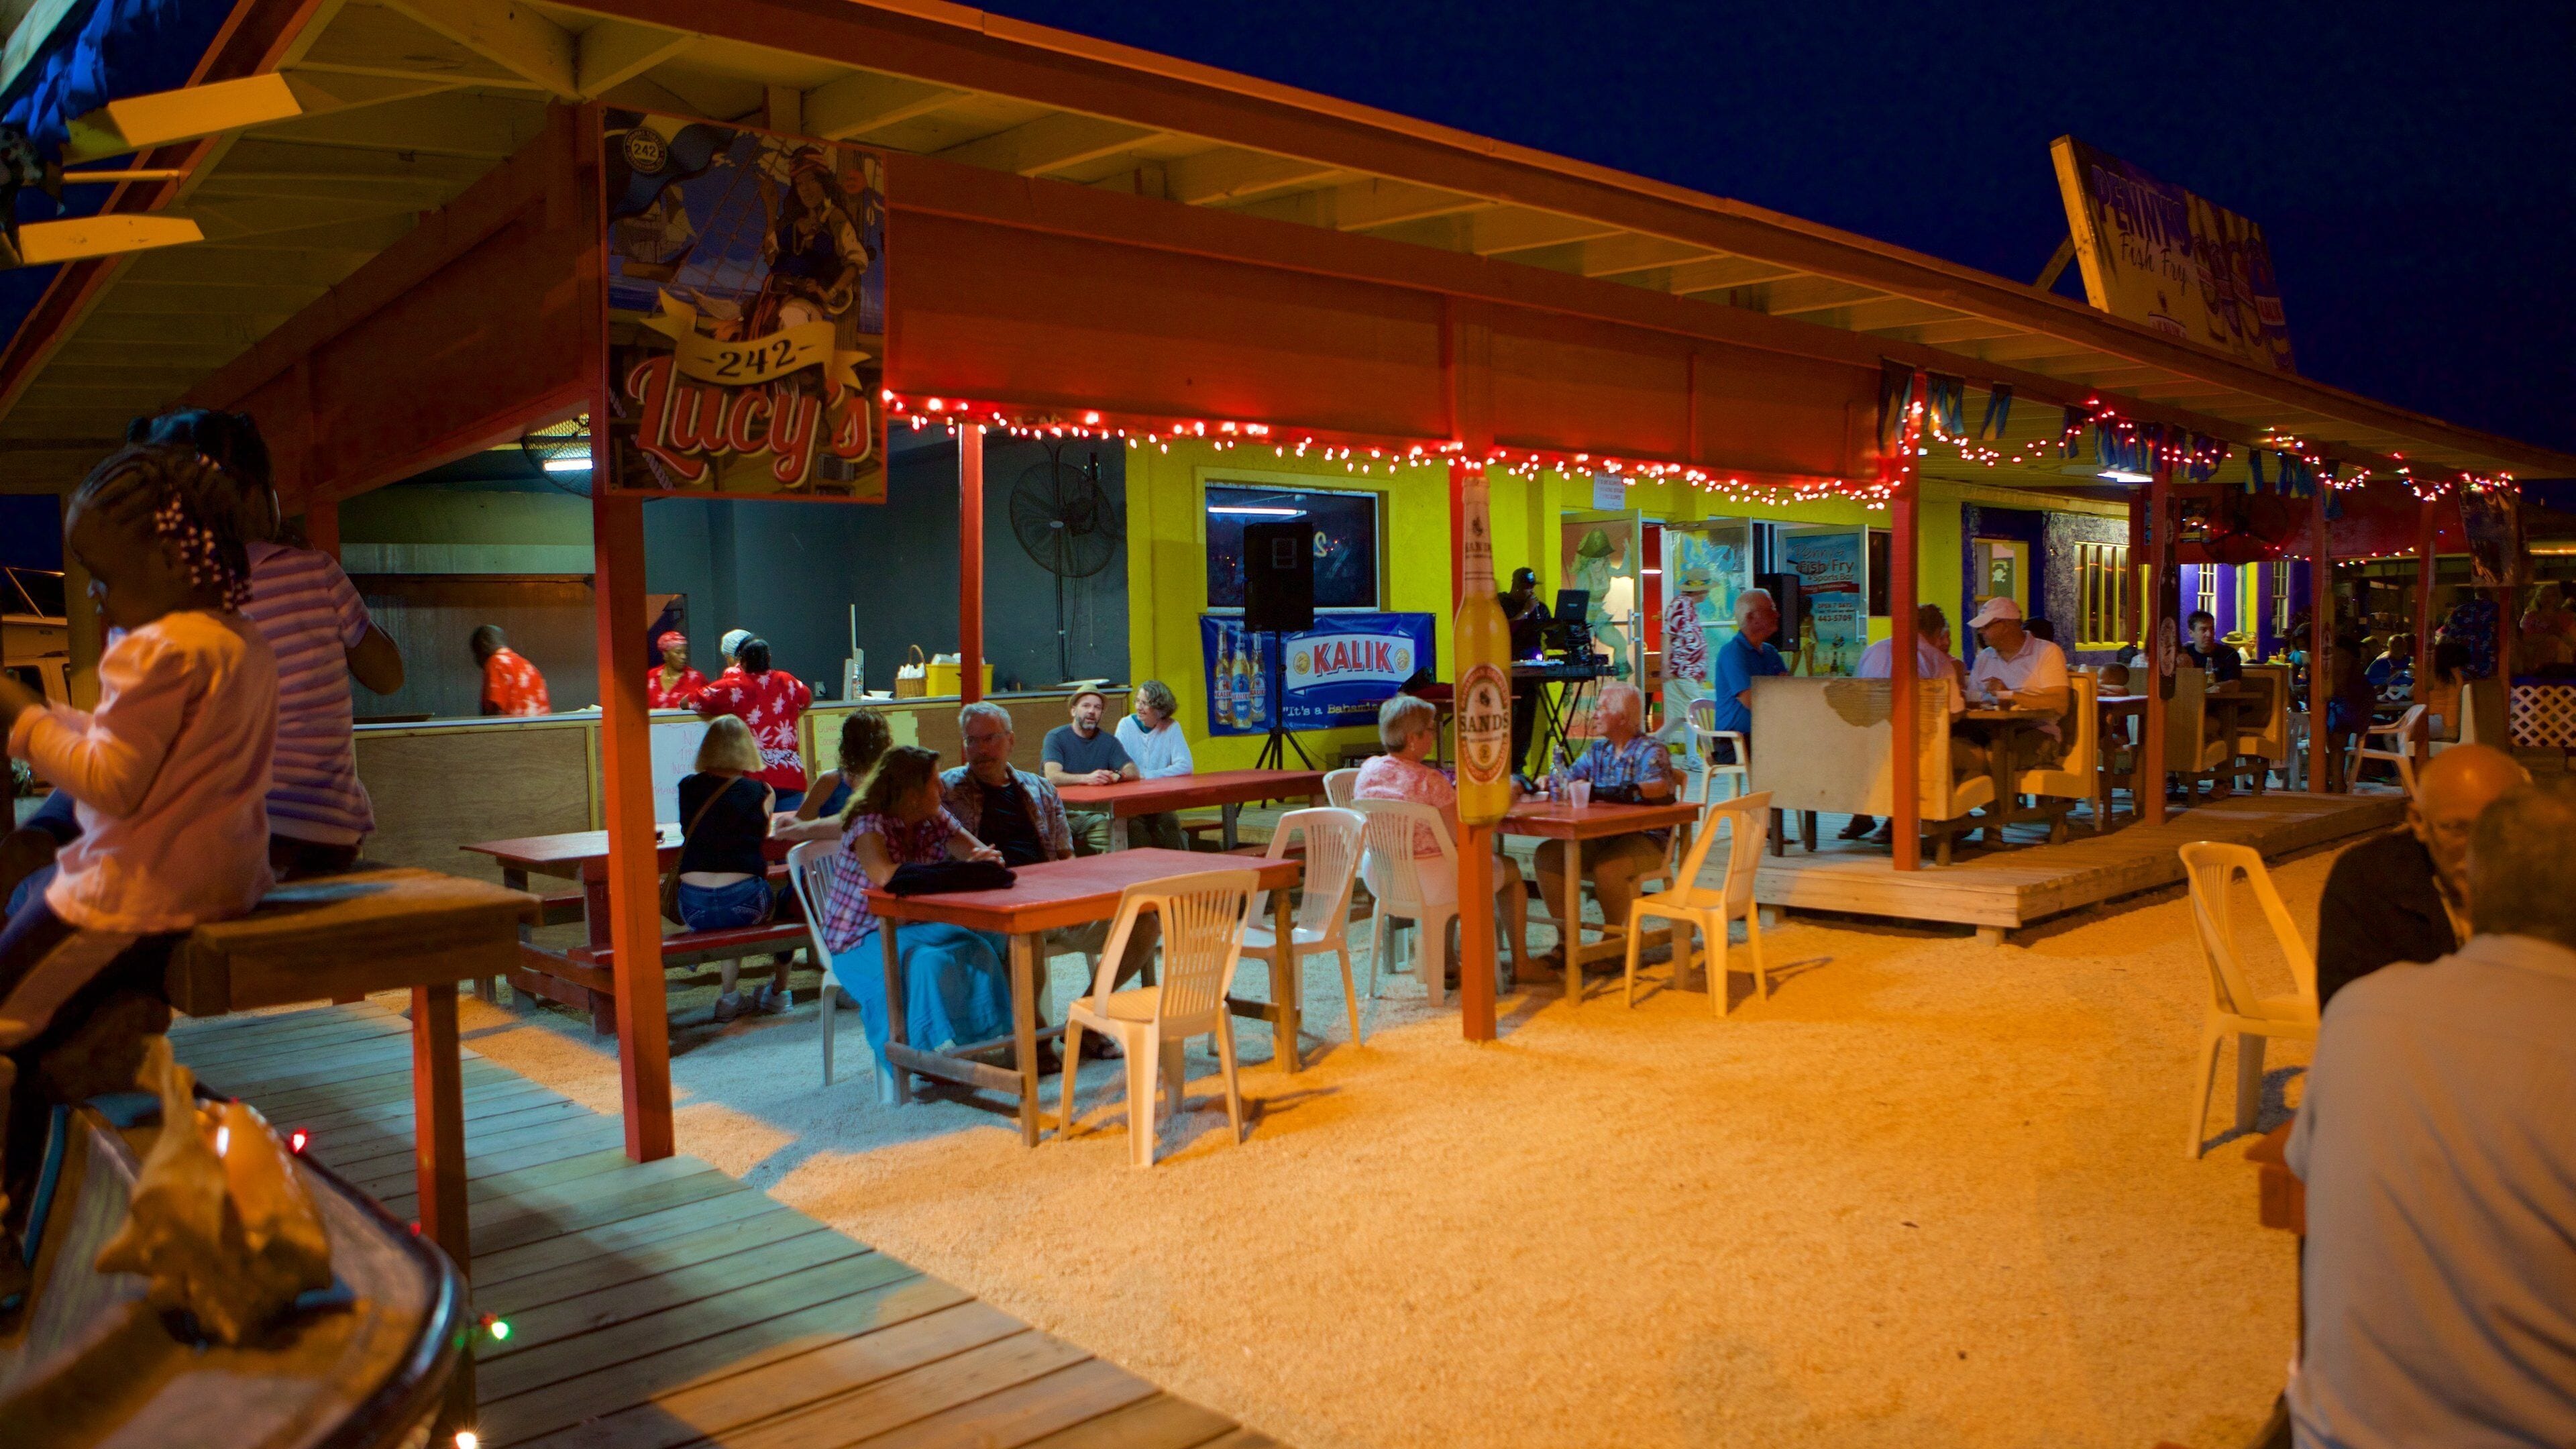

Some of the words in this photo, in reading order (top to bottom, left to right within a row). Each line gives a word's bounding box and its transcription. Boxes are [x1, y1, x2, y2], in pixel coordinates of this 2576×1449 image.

[633, 142, 655, 157] 242
[2118, 231, 2155, 273] Fish
[2160, 248, 2189, 297] Fry
[716, 339, 797, 377] 242
[628, 356, 872, 488] Lucy's
[1832, 559, 1854, 572] Fry
[1813, 574, 1838, 582] Sports
[1313, 640, 1396, 678] KALIK
[1282, 705, 1311, 717] "It's
[1314, 706, 1324, 715] a
[1326, 702, 1380, 714] Bahamia
[1460, 712, 1509, 733] SANDS
